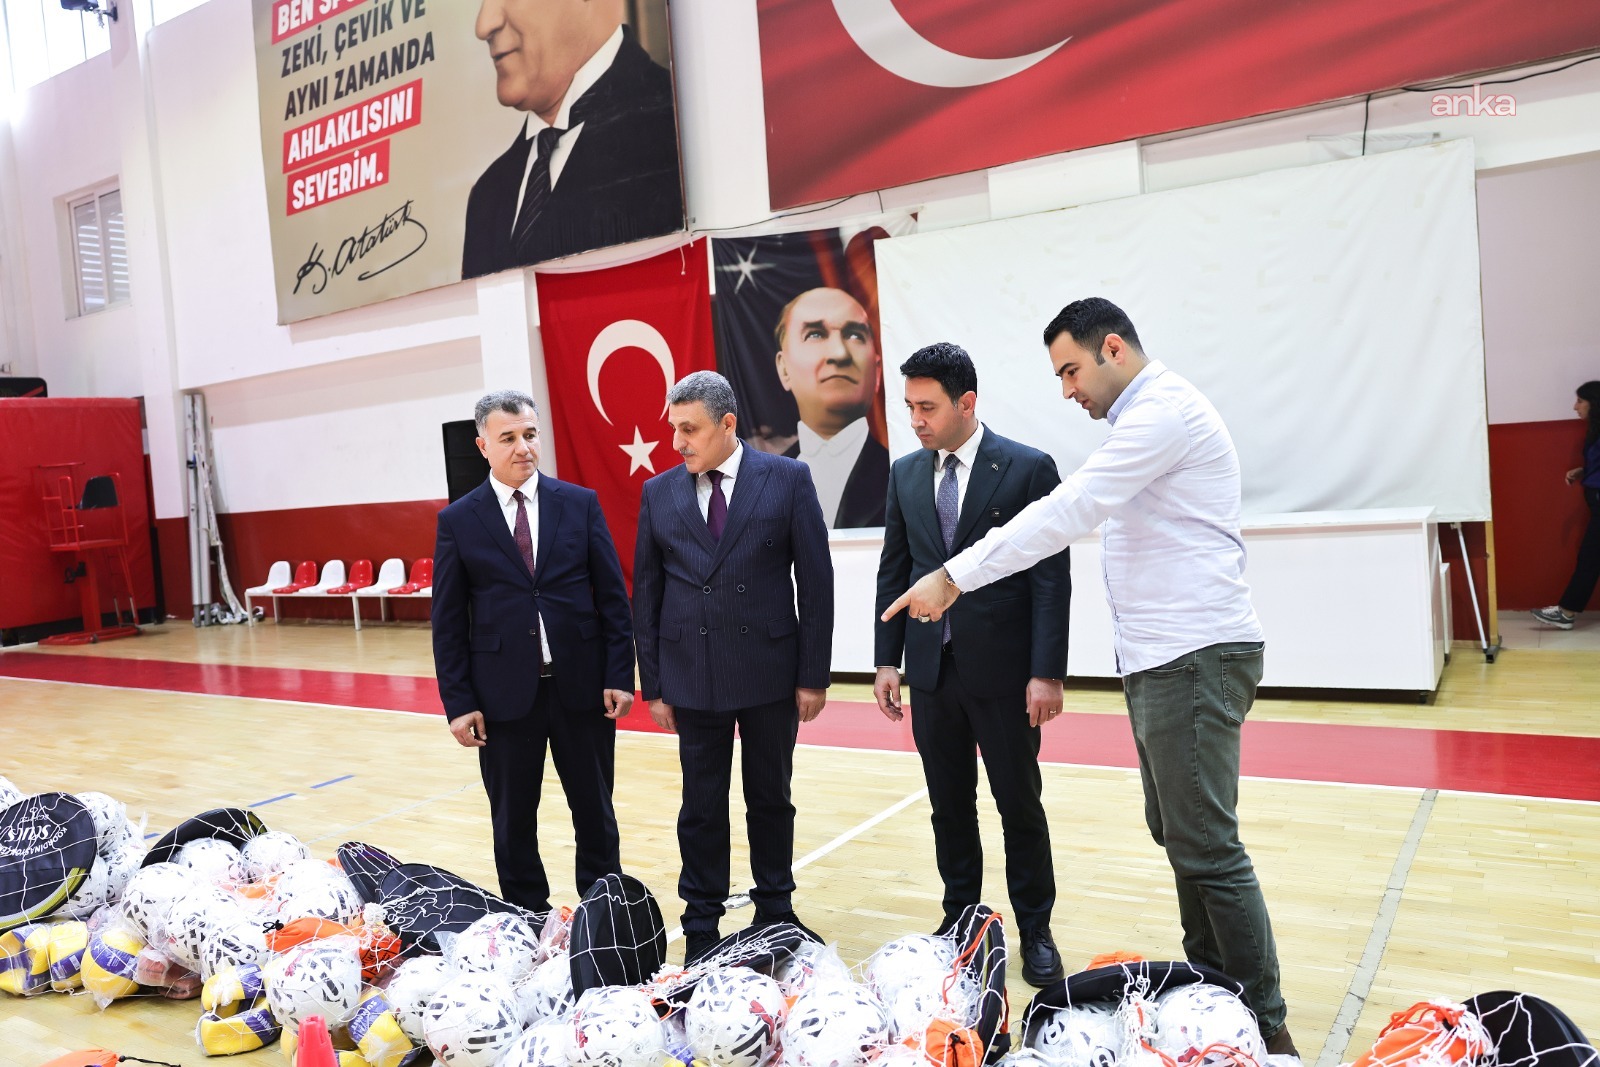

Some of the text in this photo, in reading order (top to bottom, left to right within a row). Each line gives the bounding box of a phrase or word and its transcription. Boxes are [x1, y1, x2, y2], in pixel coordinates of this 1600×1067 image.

[278, 0, 314, 36] BEN
[281, 24, 328, 78] ZEKİ,
[334, 0, 393, 61] ÇEVİK
[284, 31, 435, 121] AYNI ZAMANDA
[287, 88, 414, 165] AHLAKLISINI
[291, 149, 384, 208] SEVERİM.
